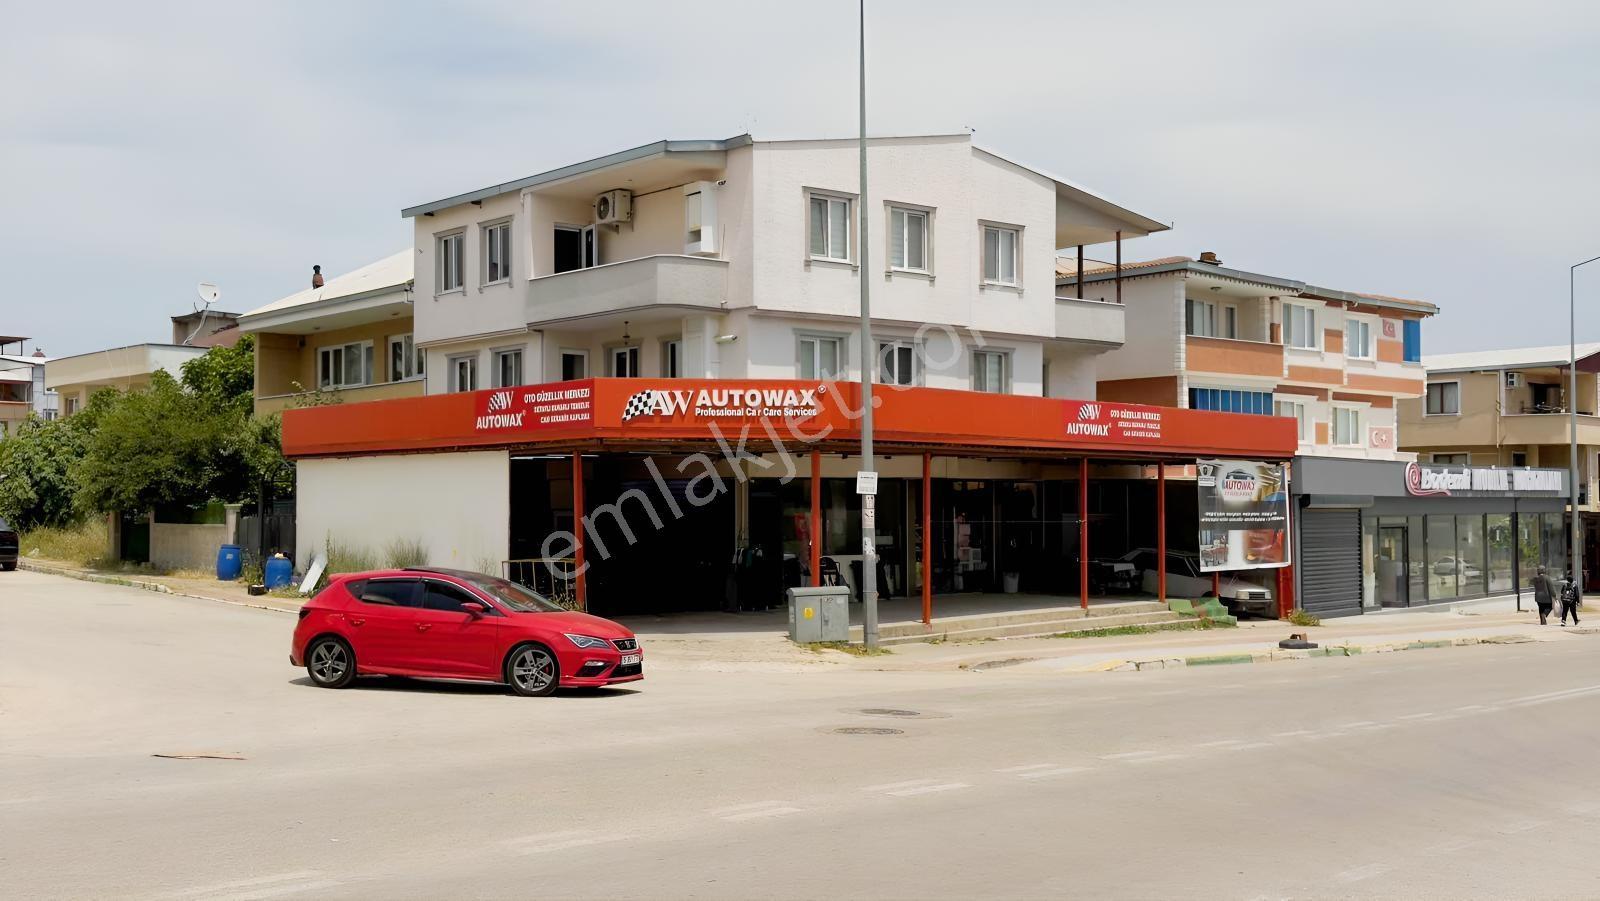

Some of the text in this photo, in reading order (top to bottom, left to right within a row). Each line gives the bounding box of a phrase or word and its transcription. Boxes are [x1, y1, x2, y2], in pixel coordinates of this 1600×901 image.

[695, 389, 816, 407] AUTOWAX
[695, 408, 817, 417] Professional Car Care Services
[476, 413, 523, 430] AUTOWAX
[1067, 423, 1109, 436] AUTOWAX
